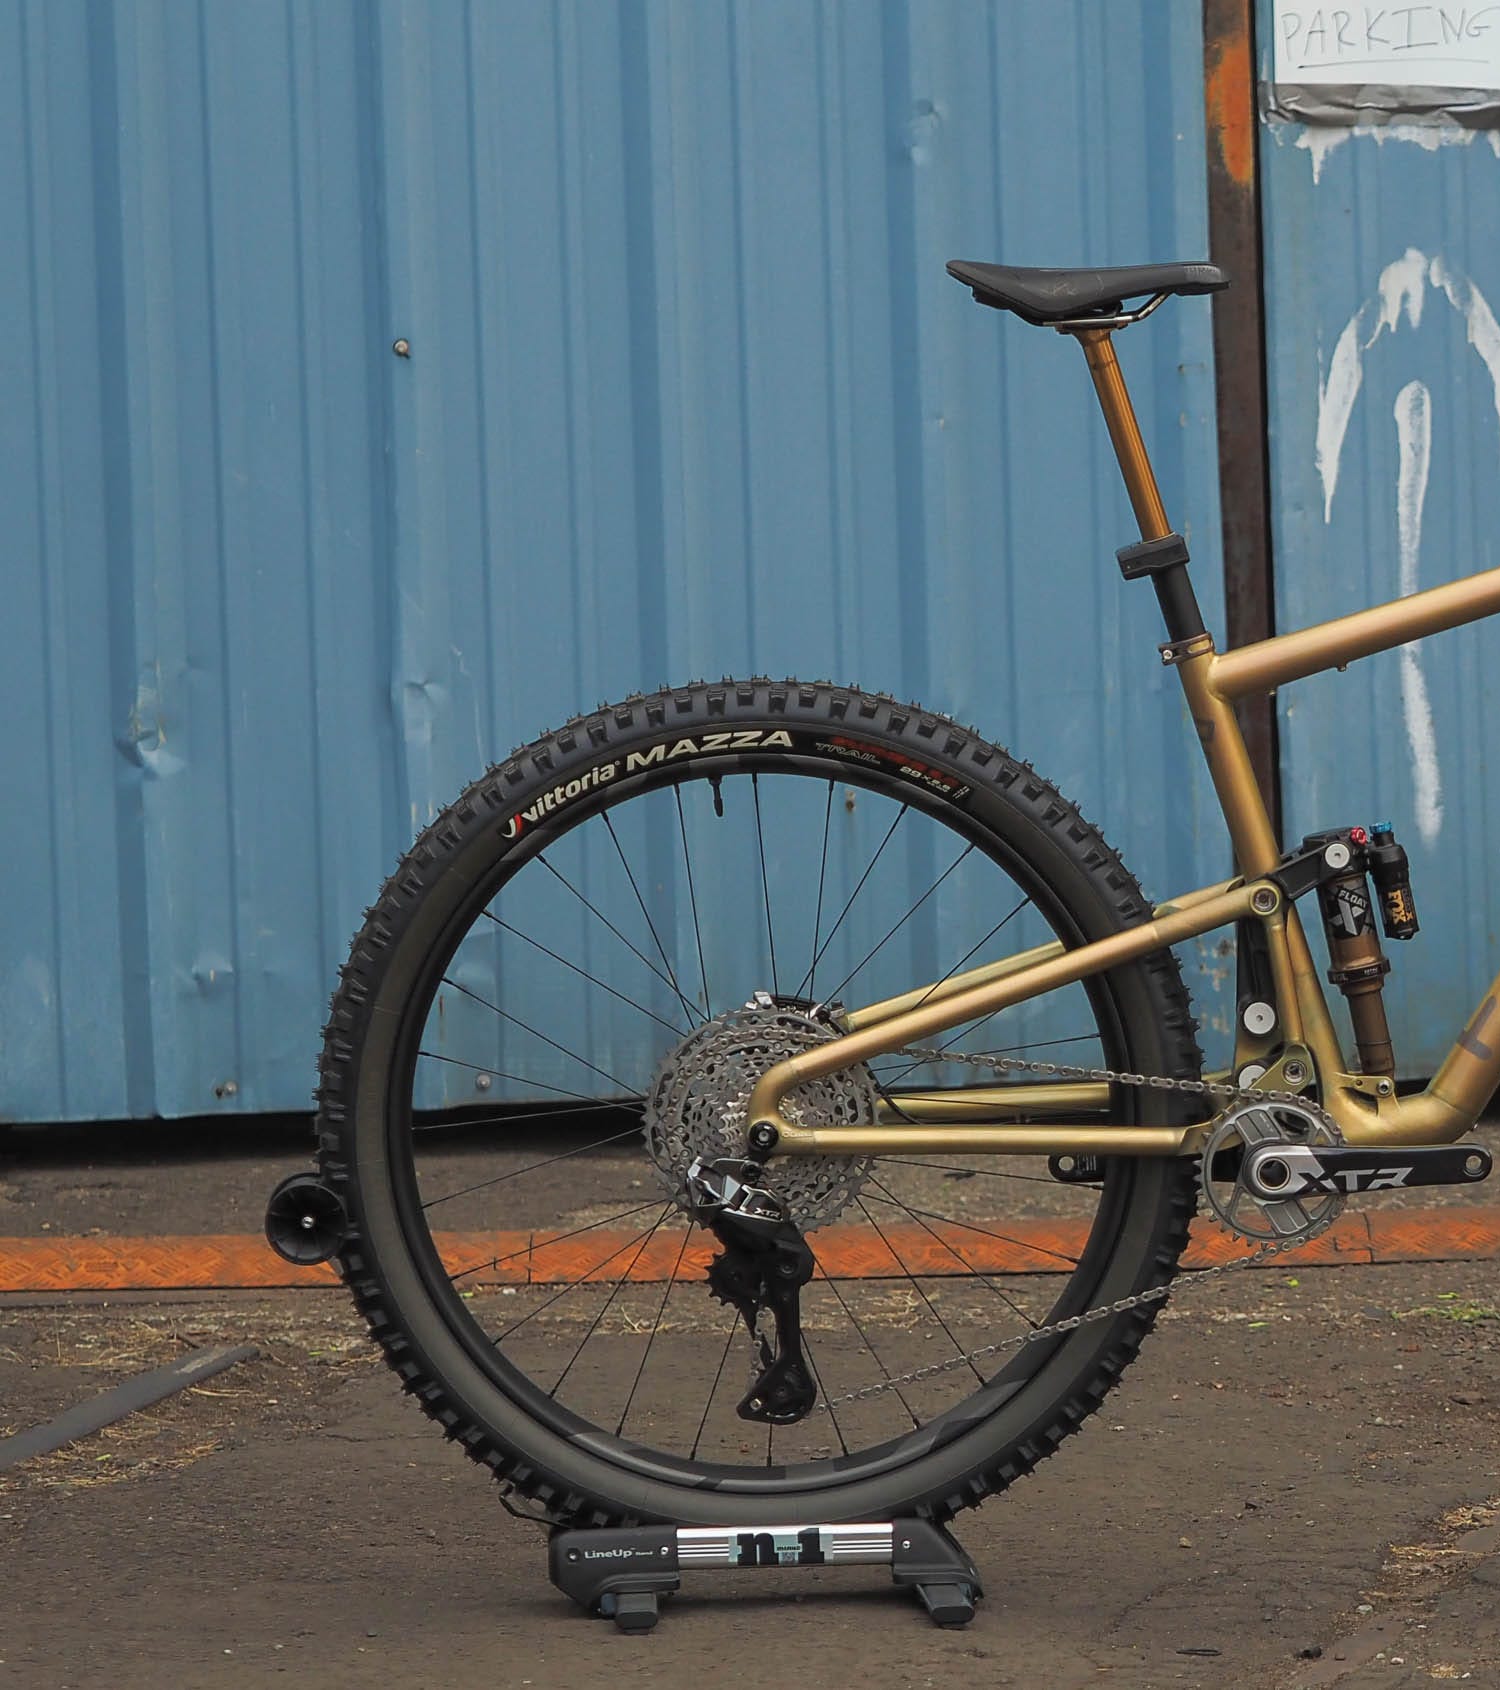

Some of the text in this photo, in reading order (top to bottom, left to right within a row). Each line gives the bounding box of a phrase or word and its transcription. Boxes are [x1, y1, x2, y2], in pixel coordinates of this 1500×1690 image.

[626, 730, 793, 771] MAZZA
[816, 743, 880, 765] TRAIL
[1339, 889, 1367, 908] FLOAT
[1296, 1166, 1415, 1194] XTR
[755, 1207, 780, 1218] XTR
[584, 1549, 633, 1559] LineUp
